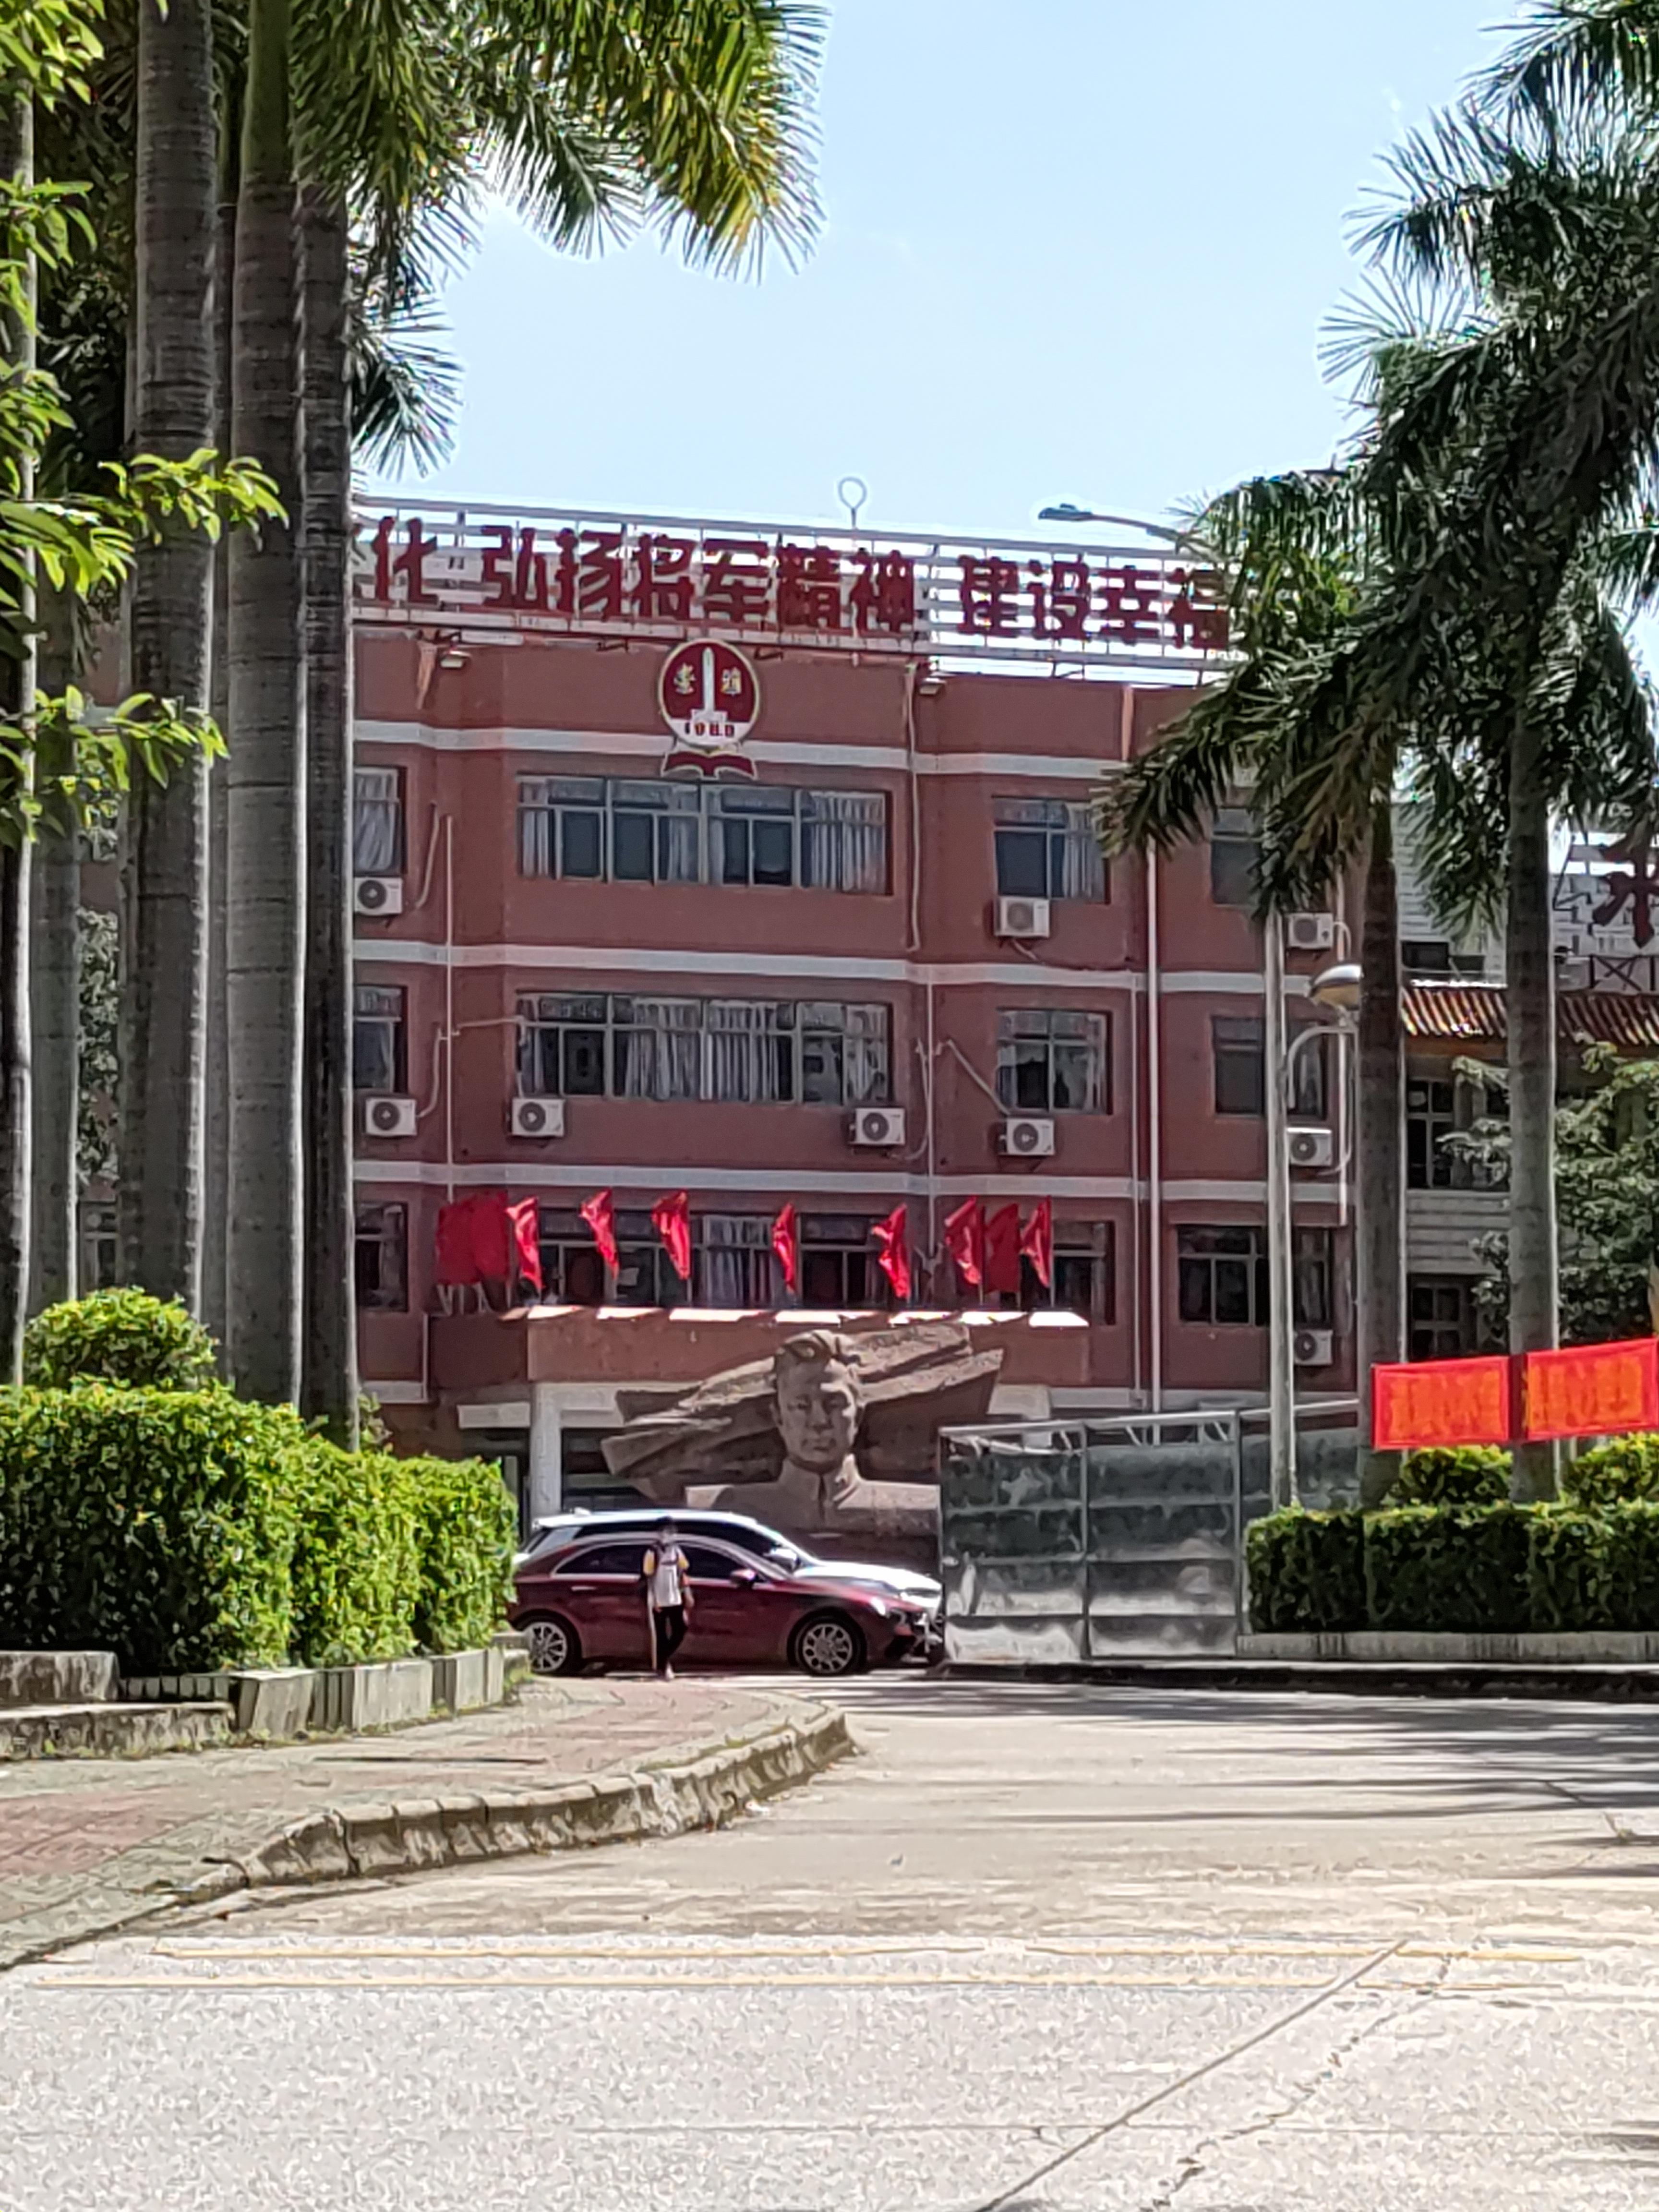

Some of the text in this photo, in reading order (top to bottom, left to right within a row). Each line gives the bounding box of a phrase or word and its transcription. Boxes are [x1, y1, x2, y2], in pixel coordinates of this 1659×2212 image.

[480, 525, 915, 634] 弘扬将军精神
